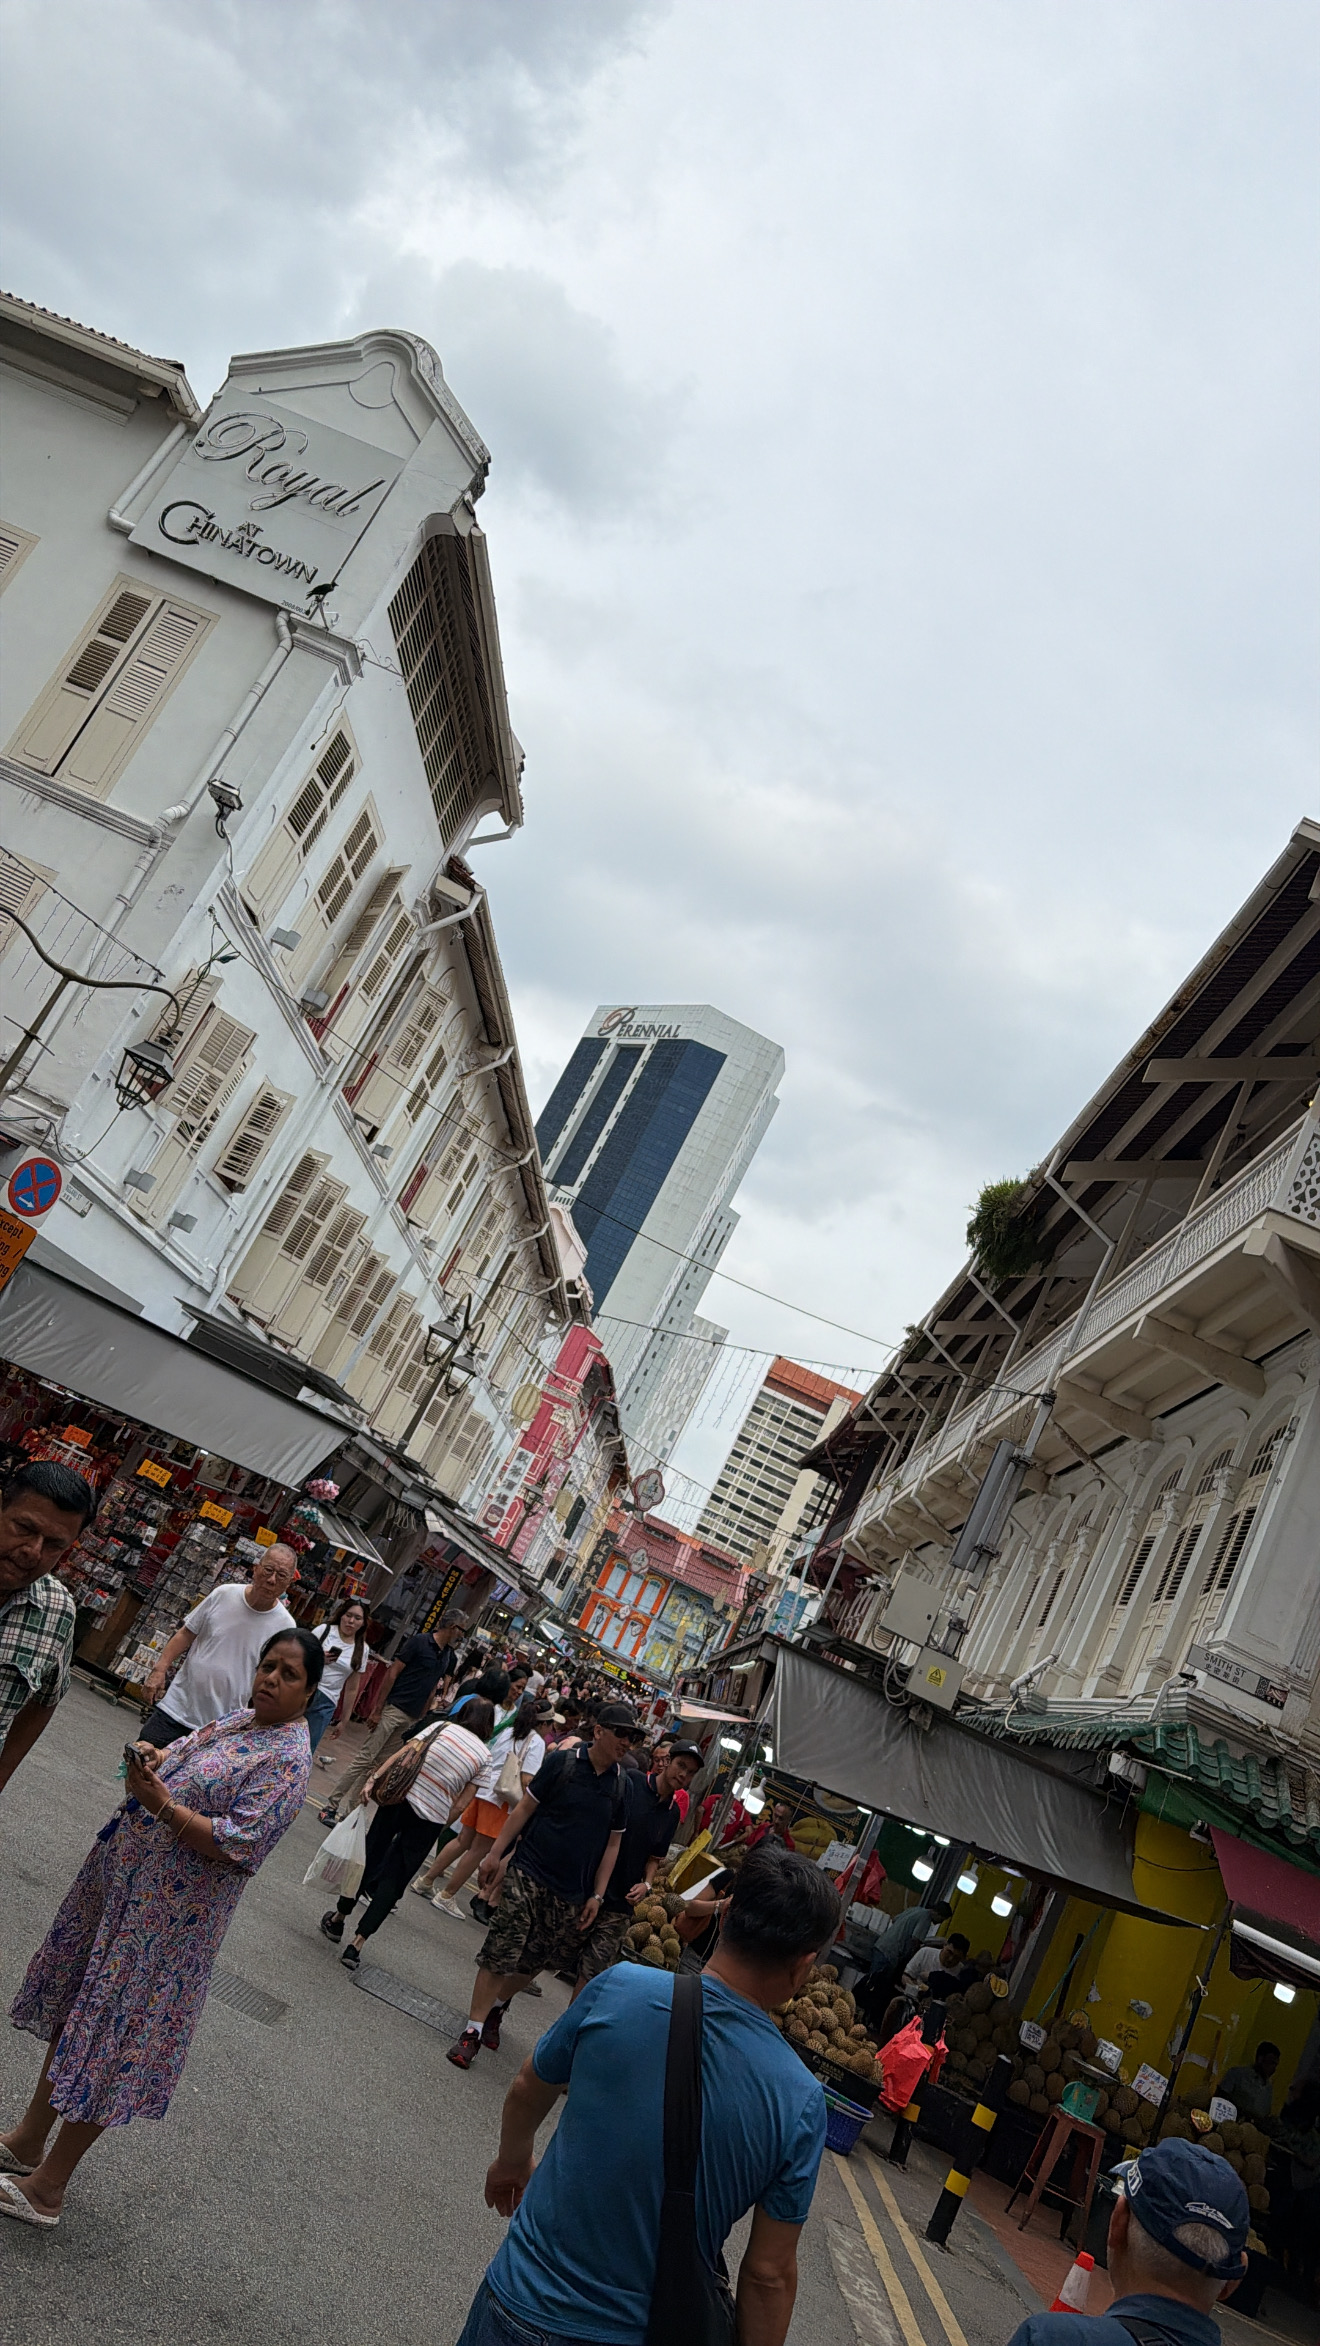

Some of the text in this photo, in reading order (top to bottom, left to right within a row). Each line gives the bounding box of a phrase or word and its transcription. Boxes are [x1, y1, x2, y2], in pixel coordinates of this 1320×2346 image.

[193, 411, 387, 517] Royal
[158, 501, 320, 584] CHINATOWN
[238, 520, 264, 538] AT
[597, 1006, 682, 1038] PERENNIAL
[0, 1216, 24, 1239] xcept
[441, 1570, 460, 1599] MONEY
[1204, 1652, 1247, 1678] SMITH ST
